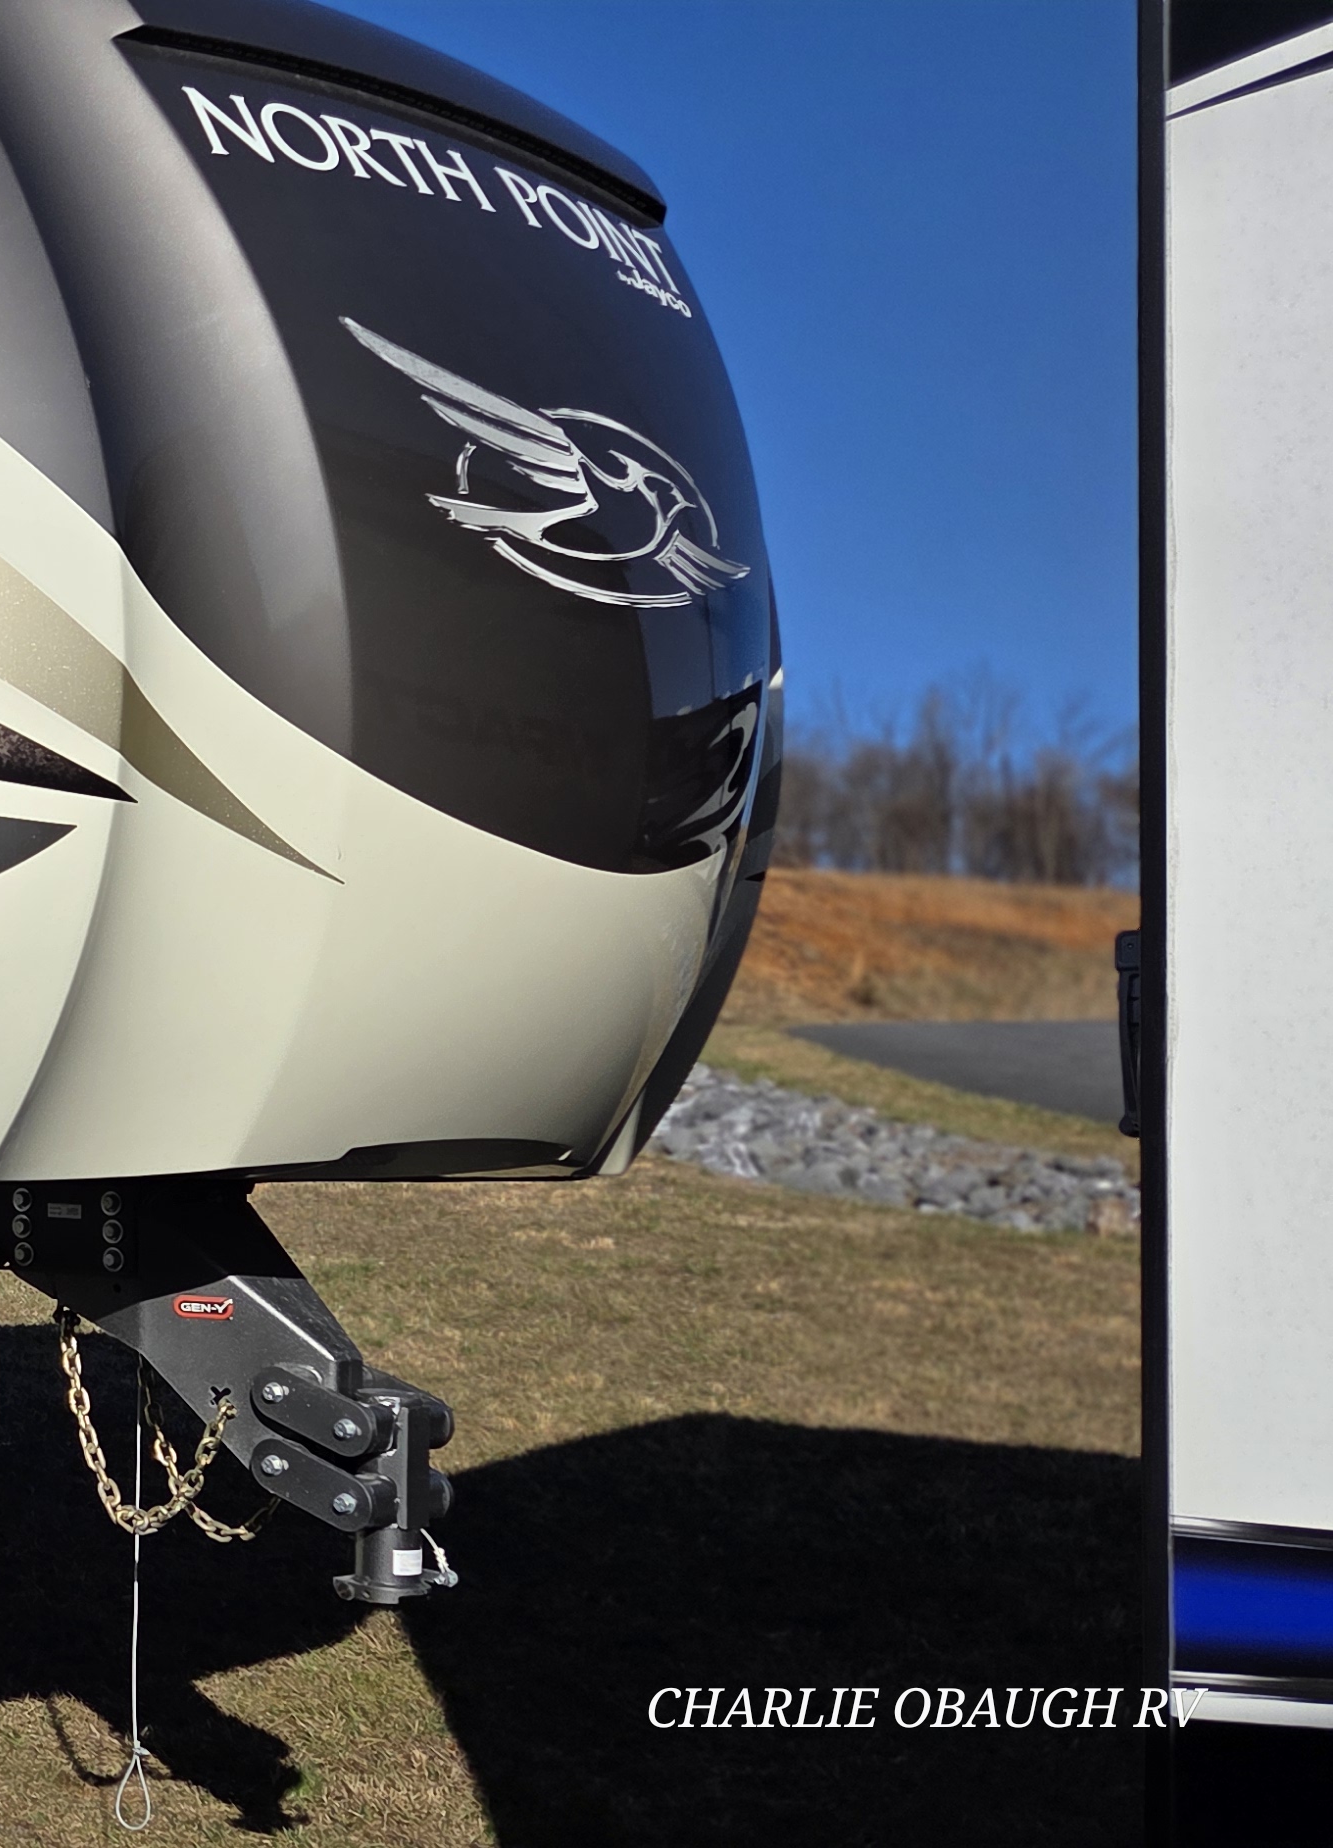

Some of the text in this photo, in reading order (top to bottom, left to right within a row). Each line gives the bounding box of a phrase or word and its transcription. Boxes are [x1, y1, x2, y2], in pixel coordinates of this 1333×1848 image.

[181, 83, 681, 296] NORTH POINT
[630, 269, 692, 318] Jayco
[180, 1298, 233, 1314] GEN-Y
